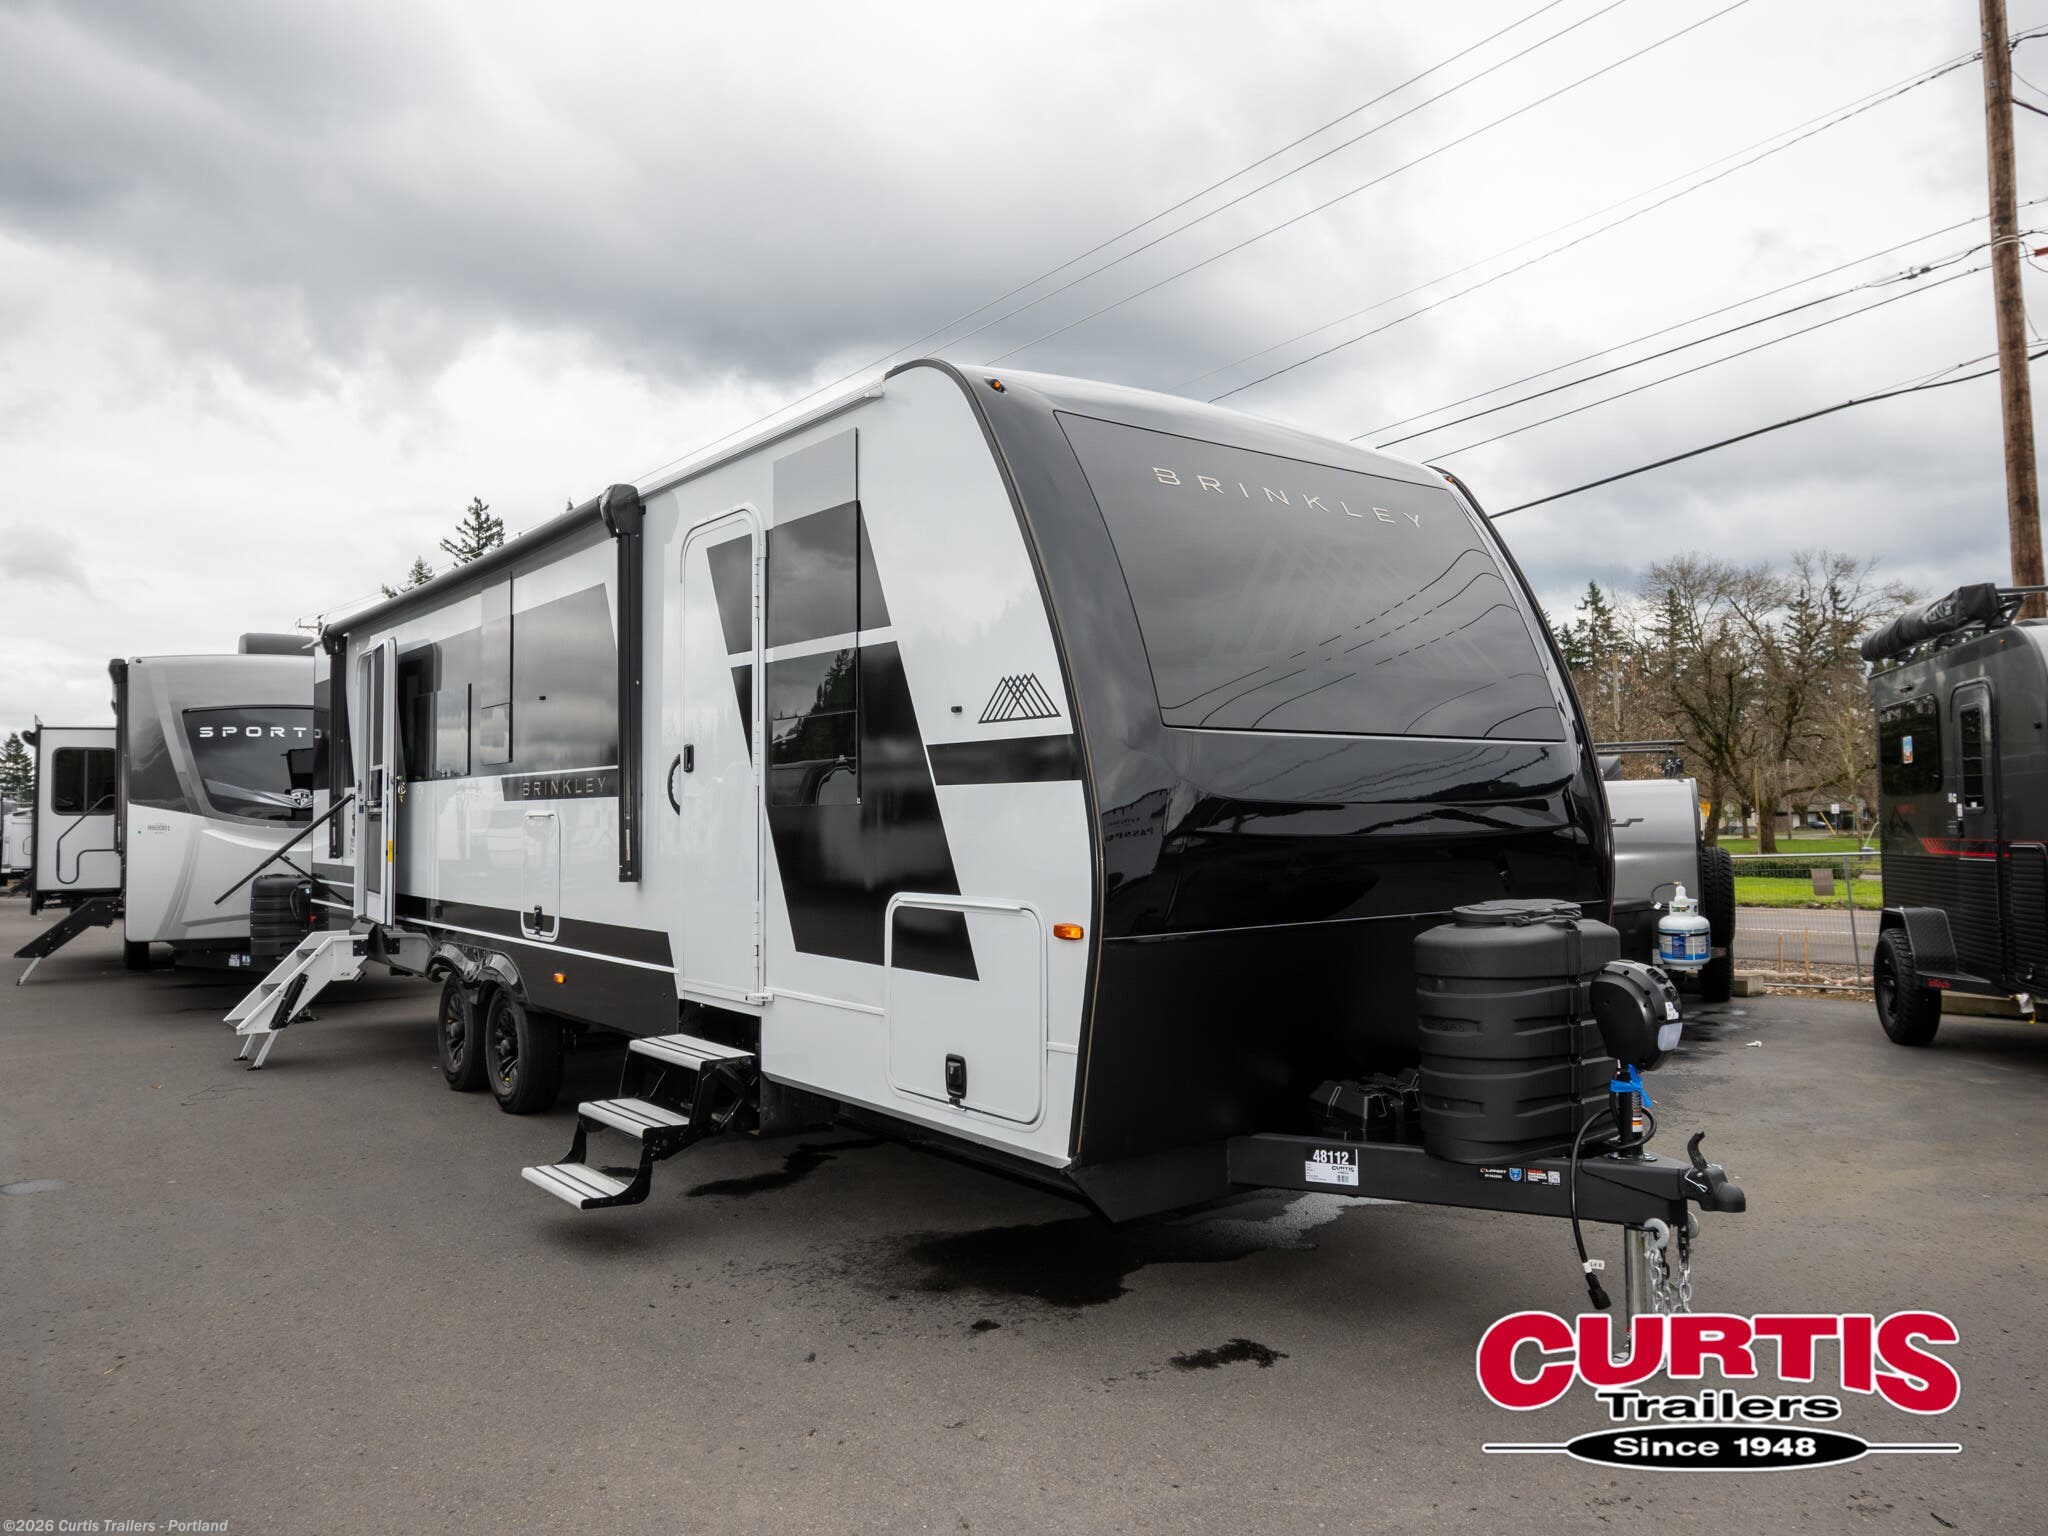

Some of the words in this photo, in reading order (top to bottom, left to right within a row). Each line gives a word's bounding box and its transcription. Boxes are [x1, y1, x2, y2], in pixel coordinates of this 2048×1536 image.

[1152, 466, 1421, 528] BRINKLEY
[522, 777, 607, 797] BRINKLEY
[1312, 1149, 1350, 1165] 48112
